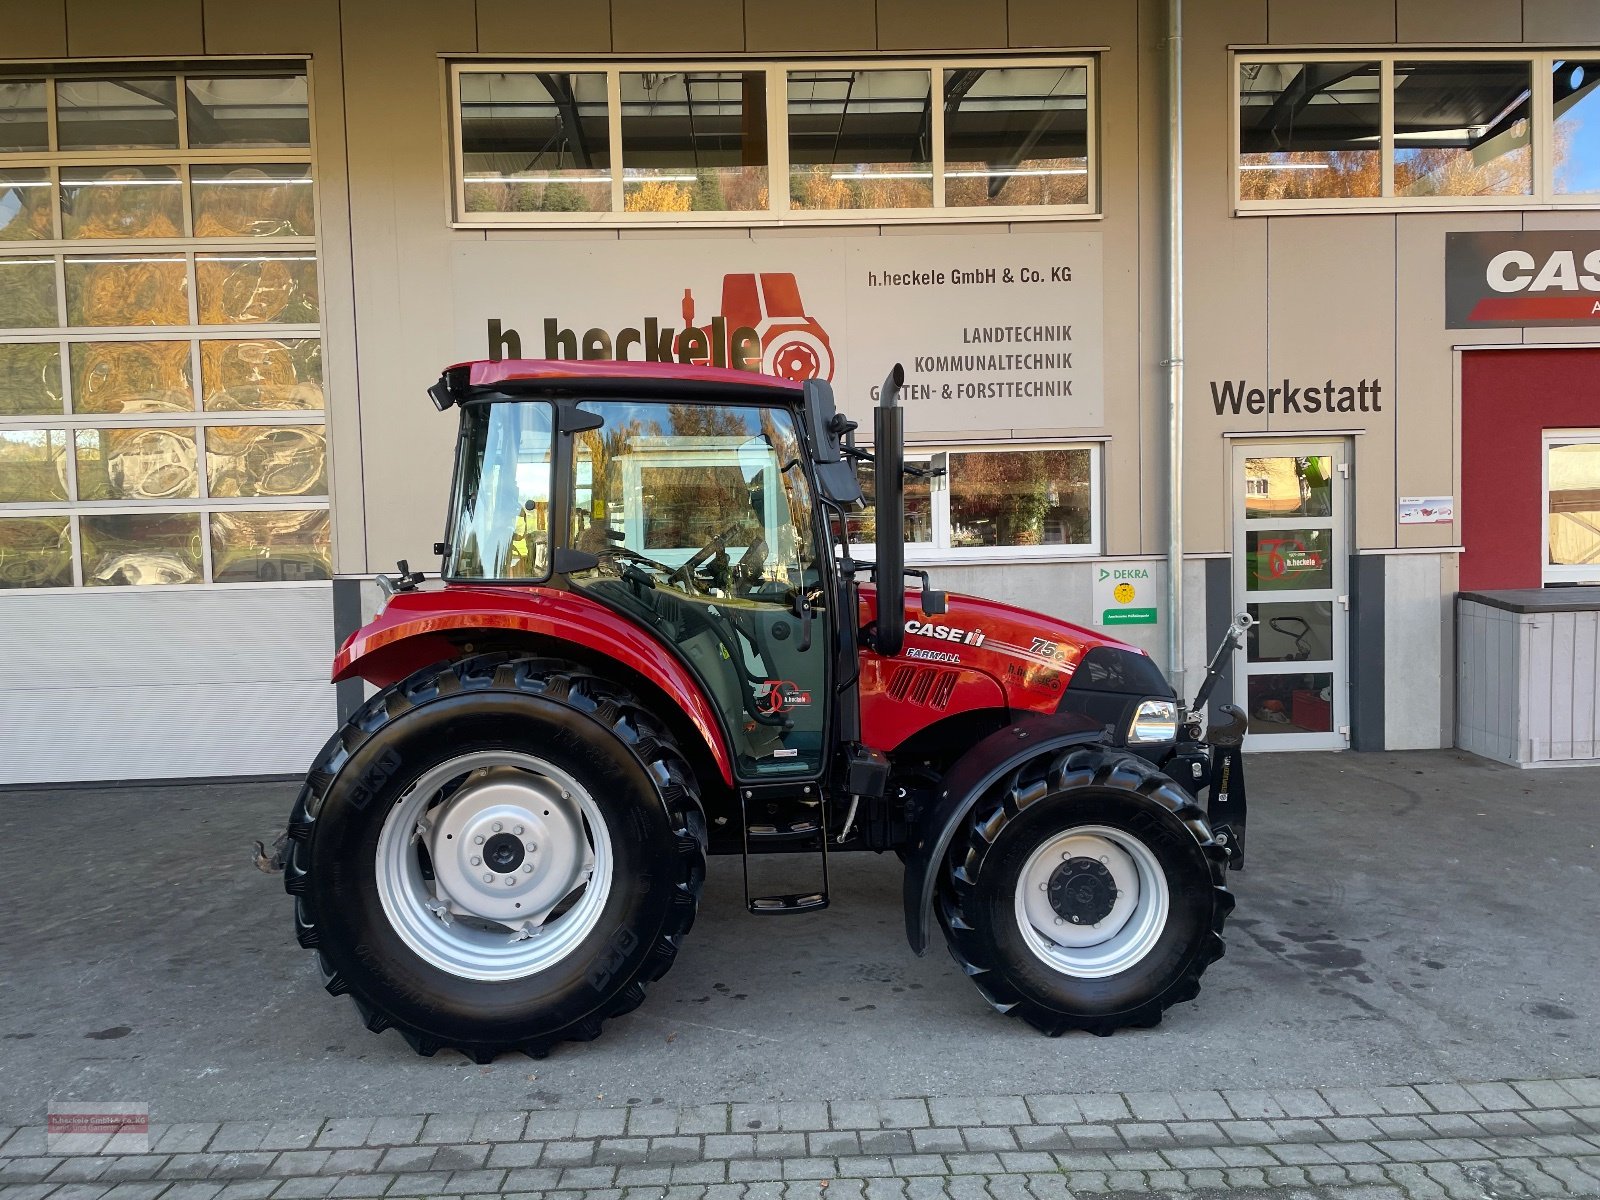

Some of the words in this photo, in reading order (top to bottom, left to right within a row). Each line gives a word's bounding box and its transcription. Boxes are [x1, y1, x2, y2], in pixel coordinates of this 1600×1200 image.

[868, 270, 945, 286] h.heckele
[951, 268, 996, 284] GmbH
[1002, 268, 1014, 283] &
[1020, 267, 1045, 283] Co.
[1051, 266, 1072, 282] KG
[963, 326, 1072, 343] LANDTECHNIK
[915, 353, 1073, 372] KOMMUNALTECHNIK
[870, 384, 937, 401] GTEN-
[941, 383, 953, 399] &
[957, 381, 1073, 399] FORSTTECHNIK
[1210, 378, 1382, 415] Werkstatt
[1113, 569, 1149, 579] DEKRA
[904, 620, 964, 642] CASE
[906, 647, 961, 663] FARMALL
